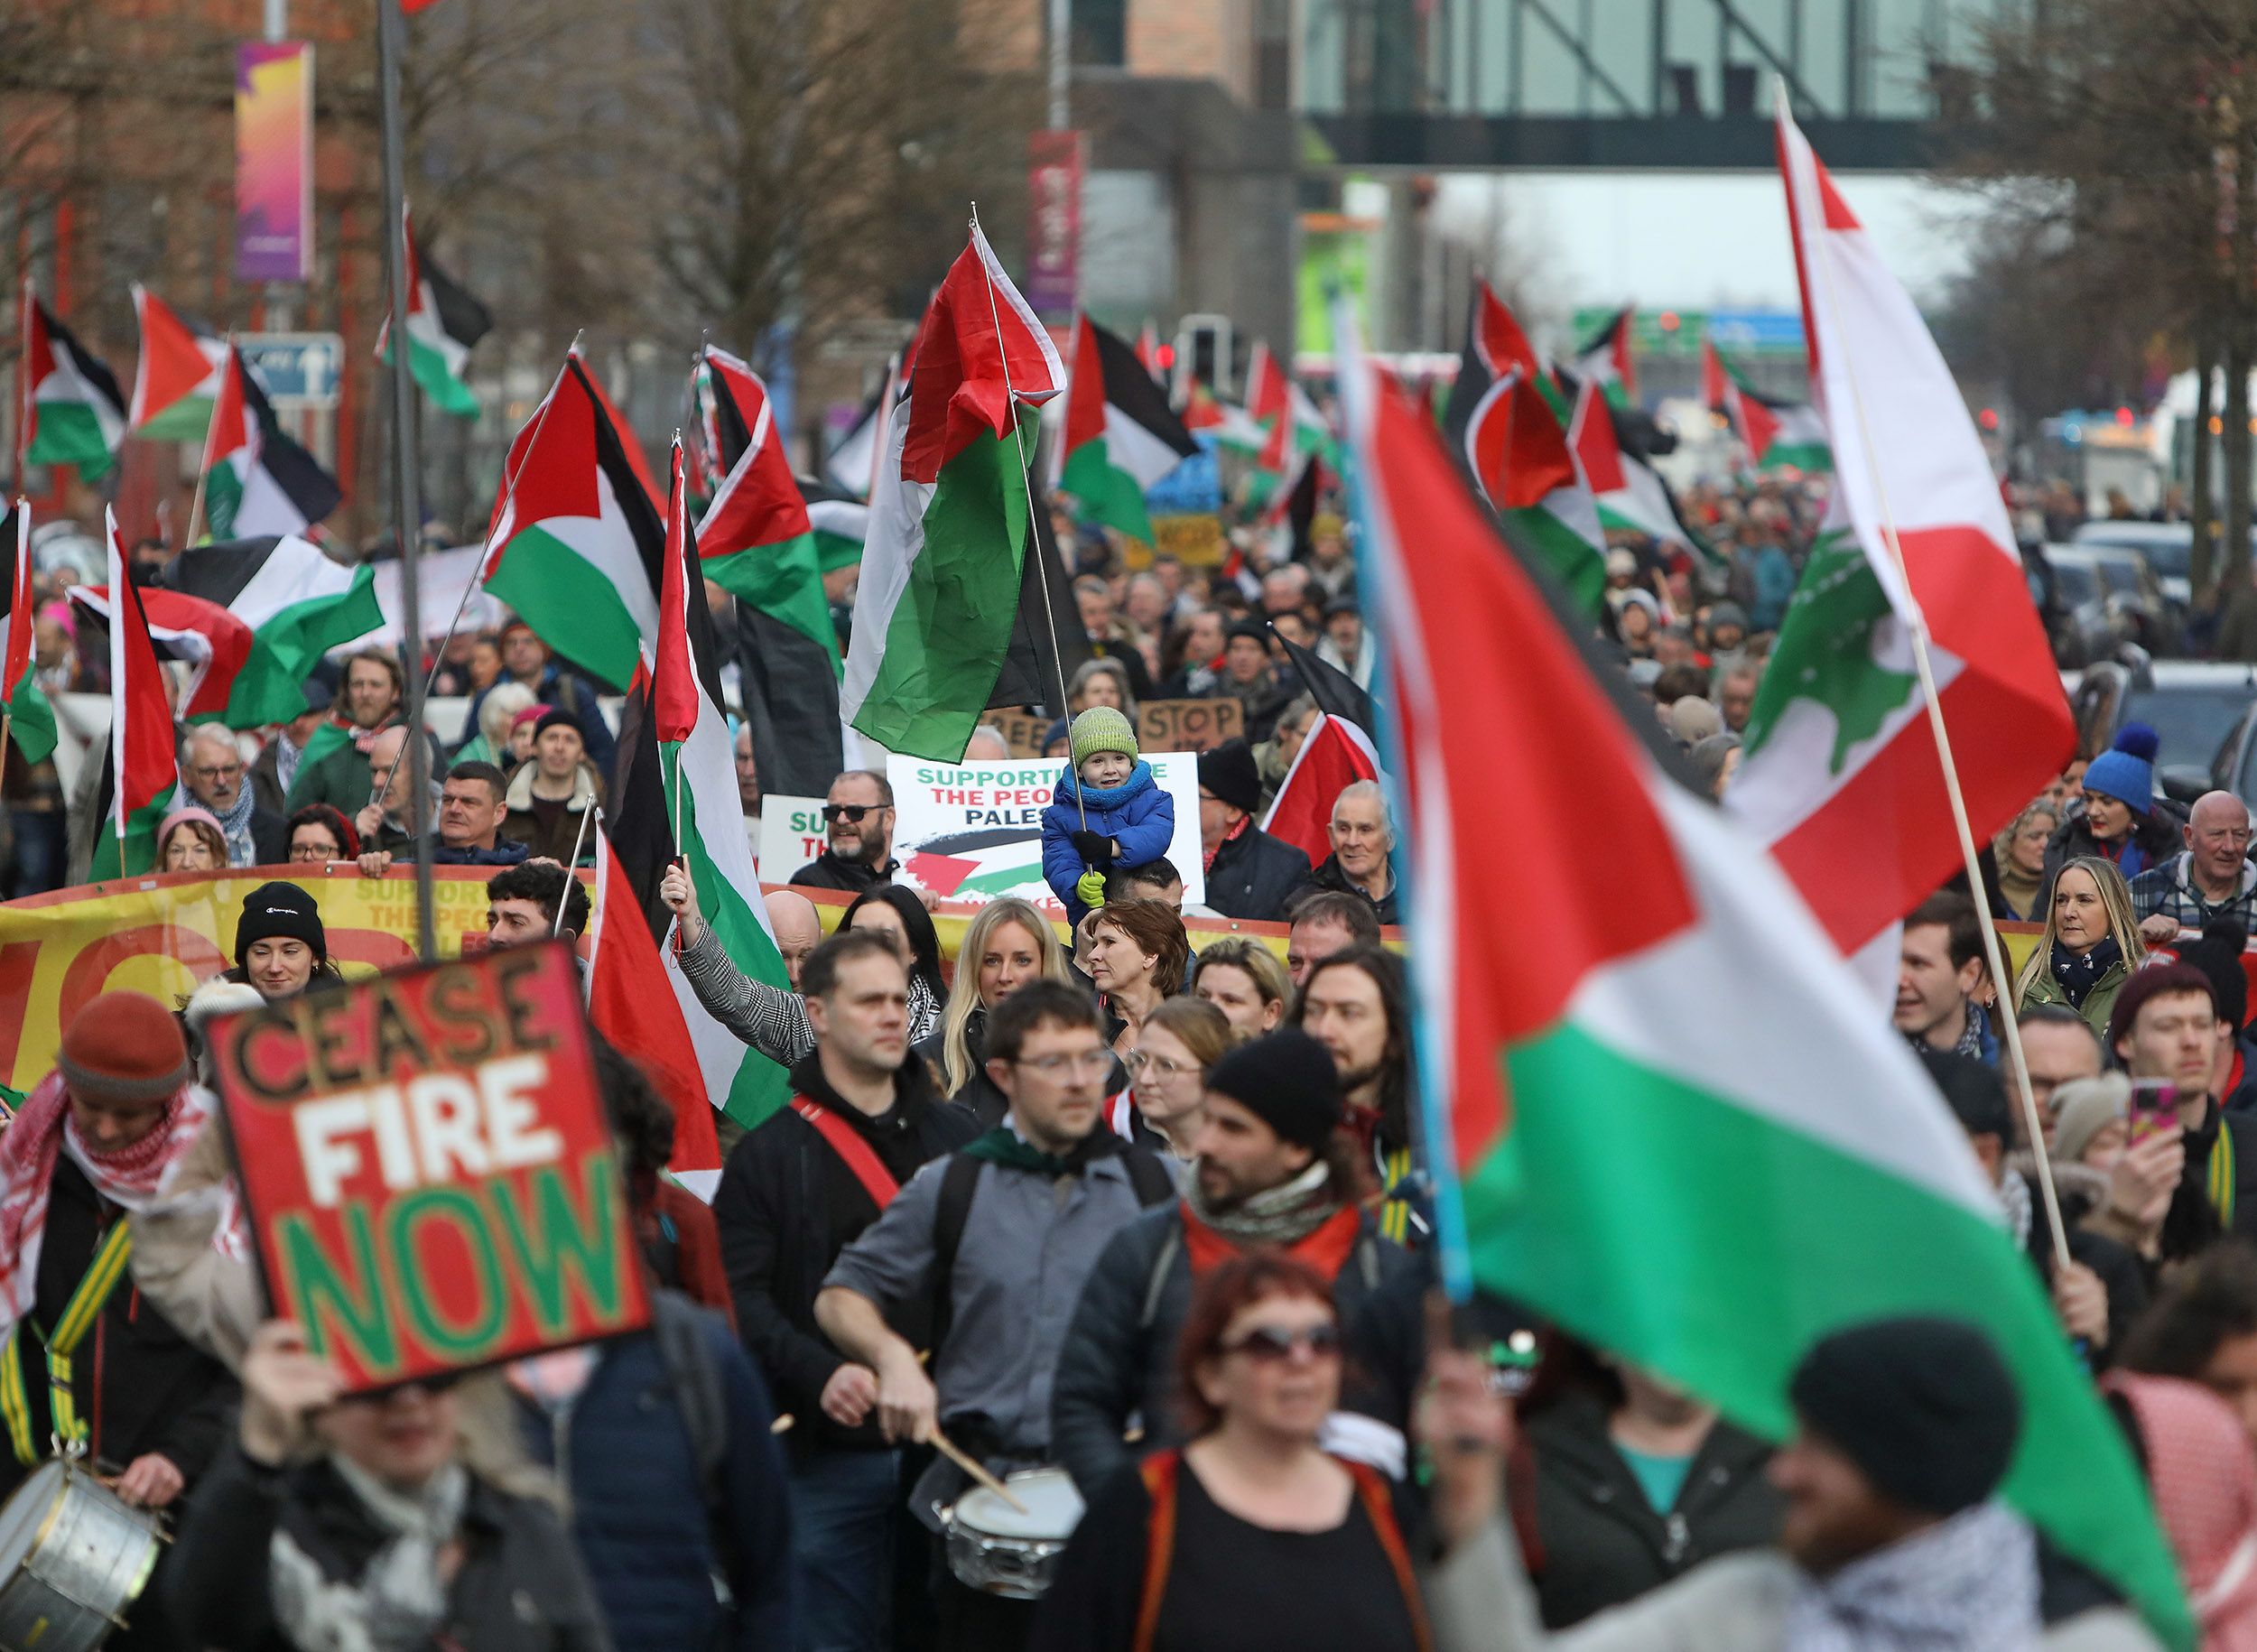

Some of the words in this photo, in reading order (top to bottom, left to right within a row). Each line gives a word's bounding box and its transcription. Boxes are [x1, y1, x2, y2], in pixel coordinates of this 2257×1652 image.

[989, 714, 1047, 749] REE
[1146, 701, 1234, 738] STOP
[916, 768, 1061, 786] SUPPORTI
[931, 788, 984, 806] THE
[993, 789, 1051, 806] PEO
[789, 812, 825, 833] SU
[966, 808, 1045, 825] PALE
[265, 906, 299, 914] Champion
[435, 908, 488, 932] PEO
[234, 957, 557, 1101] CEASE
[293, 1053, 562, 1207] FIRE
[278, 1150, 618, 1371] NOW
